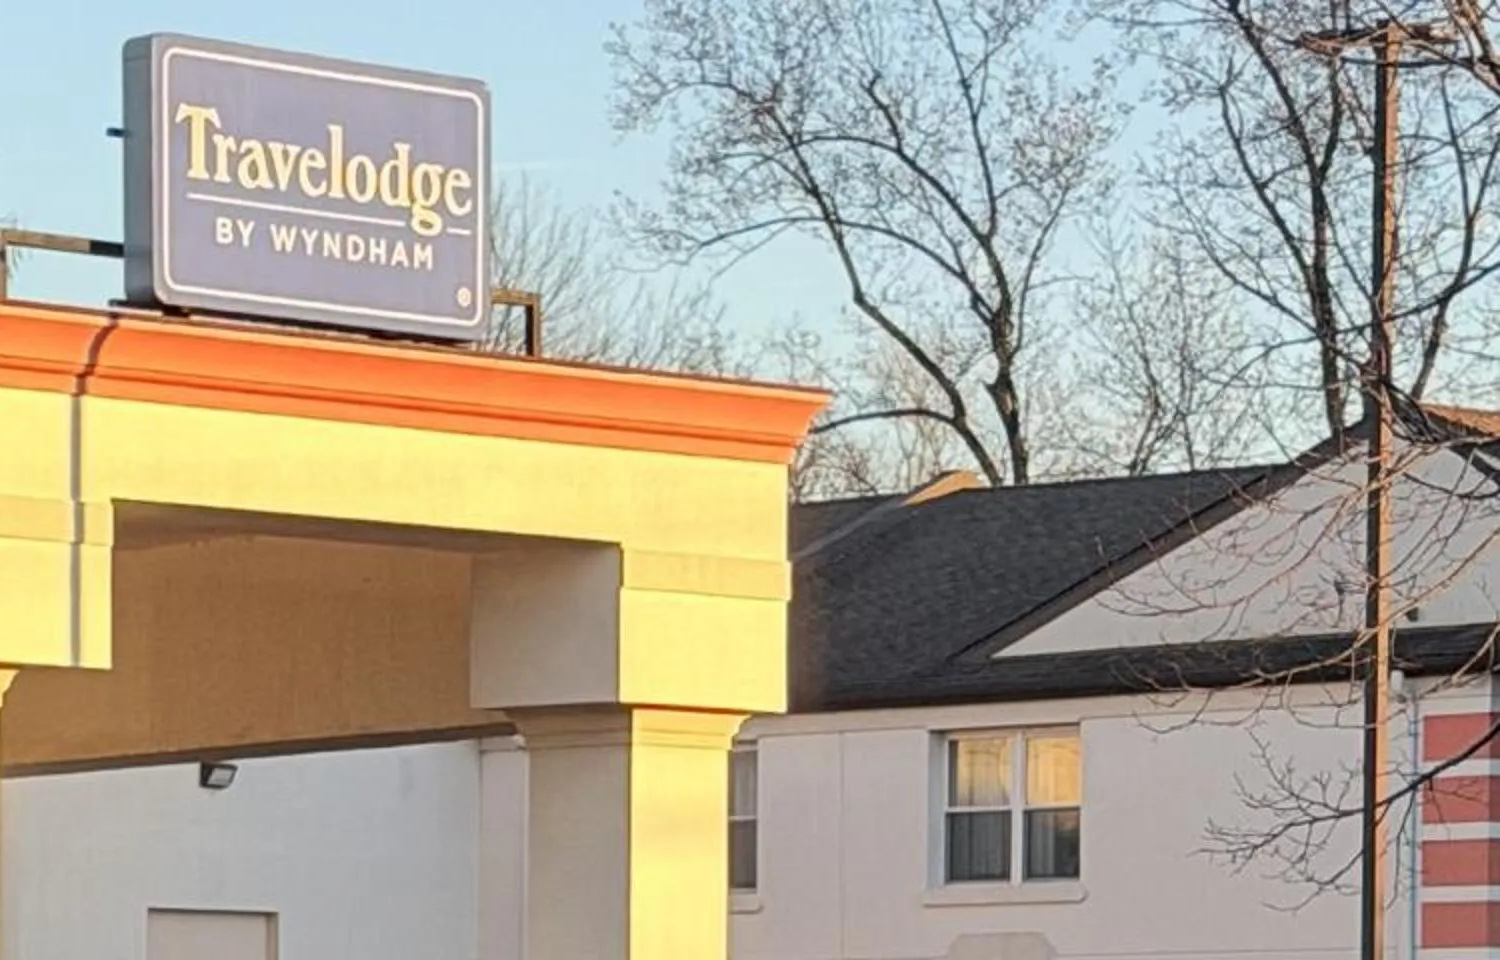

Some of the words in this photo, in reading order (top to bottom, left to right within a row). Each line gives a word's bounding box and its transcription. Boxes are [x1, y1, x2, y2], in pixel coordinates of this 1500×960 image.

[175, 102, 472, 236] Travelodge
[215, 217, 255, 247] BY
[270, 223, 434, 271] WYNDHAM
